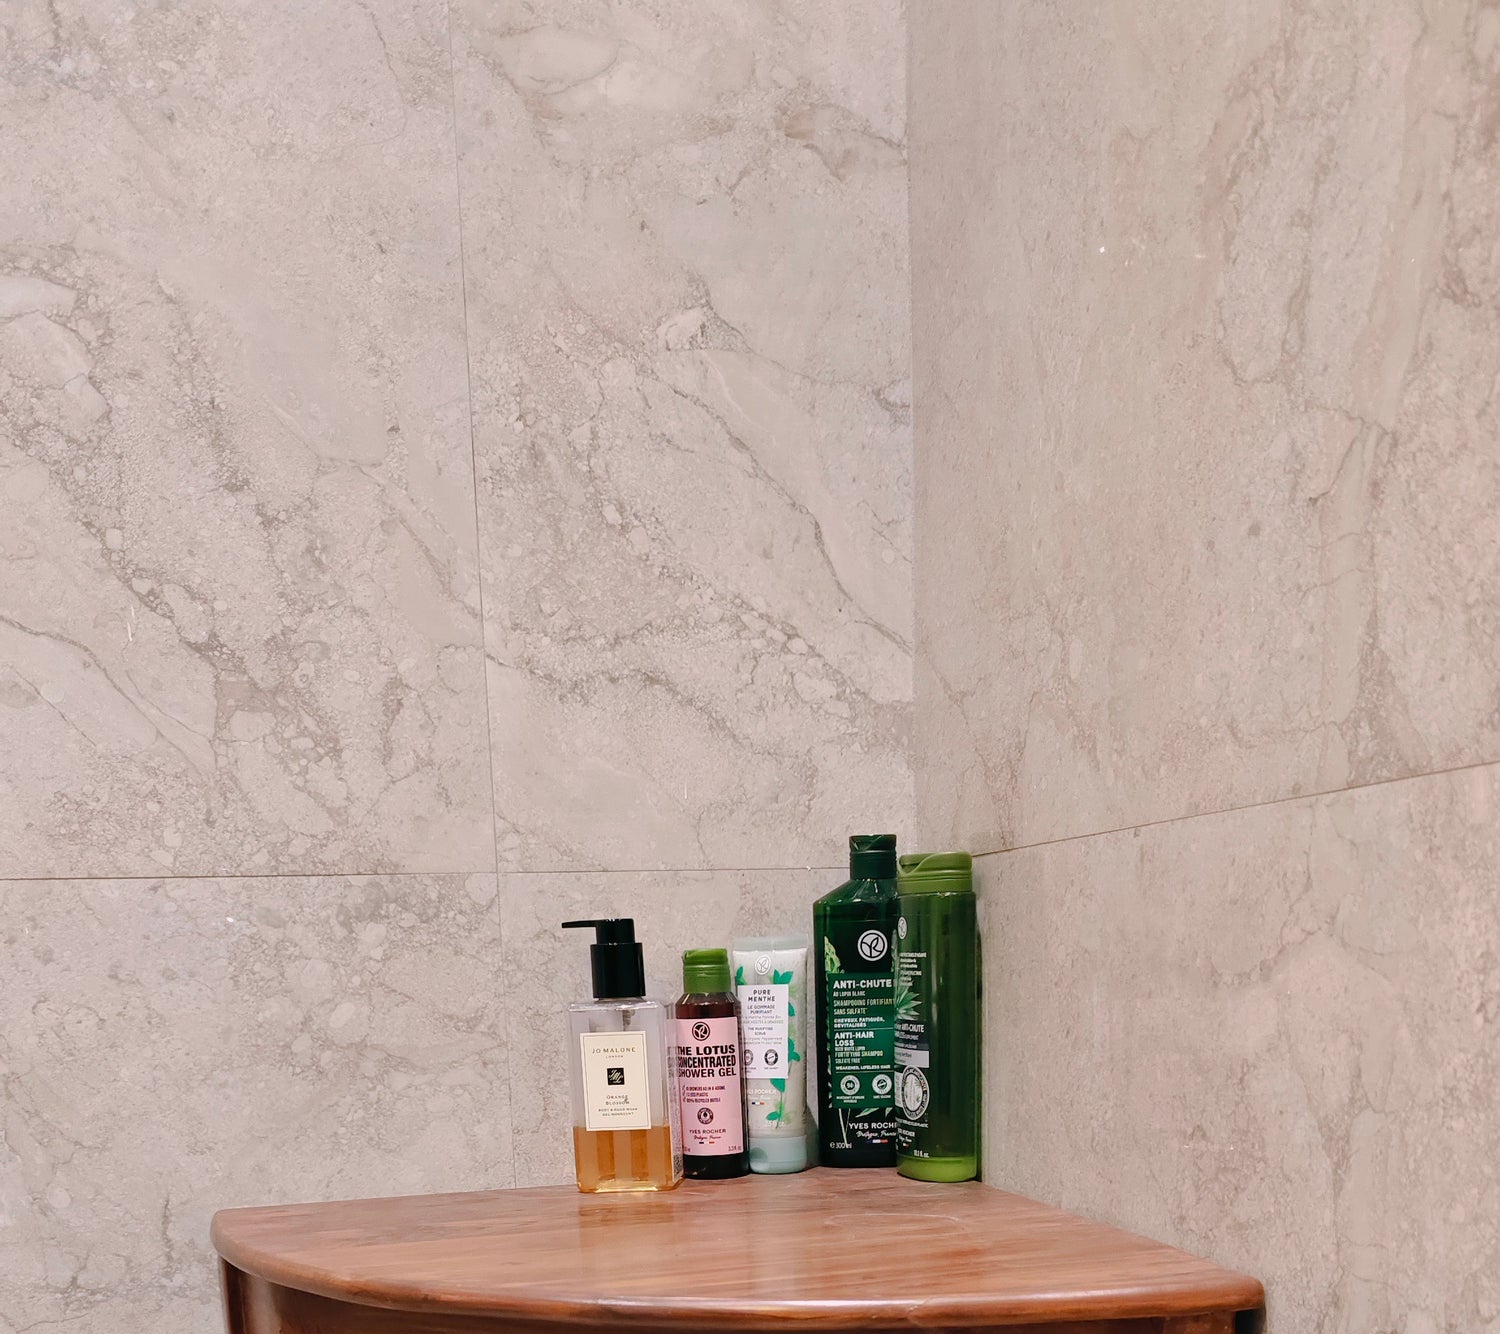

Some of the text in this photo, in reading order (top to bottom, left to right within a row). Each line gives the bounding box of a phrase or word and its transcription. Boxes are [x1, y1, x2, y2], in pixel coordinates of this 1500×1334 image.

[833, 979, 892, 988] ANTI-CHUTE
[678, 1044, 735, 1055] THE LOTUS
[679, 1068, 714, 1078] SHOWER
[719, 1067, 736, 1077] GEL
